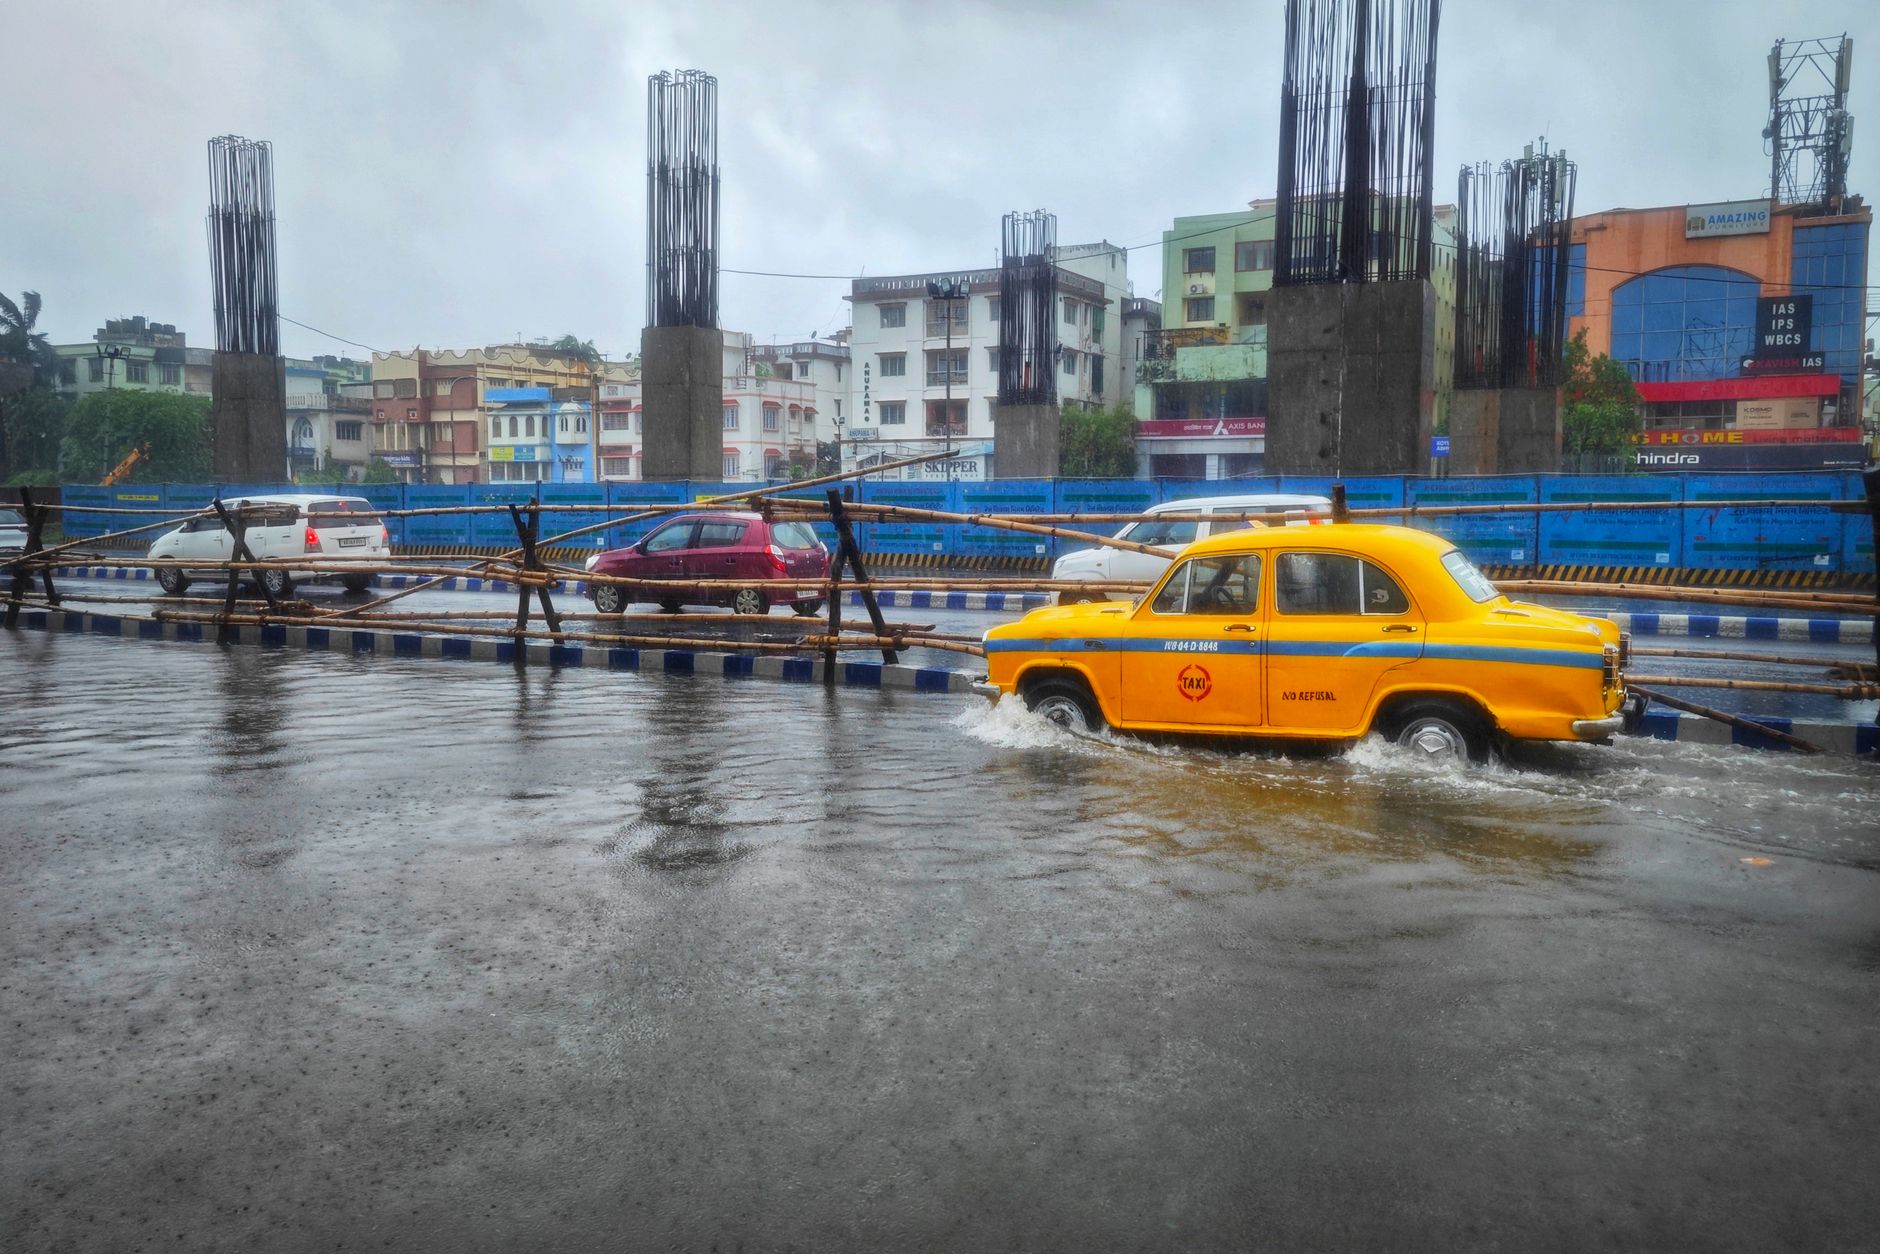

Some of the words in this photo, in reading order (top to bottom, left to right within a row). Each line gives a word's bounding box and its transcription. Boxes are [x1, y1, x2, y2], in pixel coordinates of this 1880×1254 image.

[1708, 211, 1766, 224] AMAZING
[1772, 303, 1795, 315] IAS
[1772, 319, 1794, 330] IPS
[1765, 334, 1801, 346] WBCS
[1802, 357, 1822, 367] IAS
[1228, 422, 1245, 430] AXIS
[1660, 431, 1744, 444] HOME
[1183, 677, 1205, 689] TAXI
[1282, 691, 1296, 701] NO
[1299, 691, 1337, 701] REFUSAL
